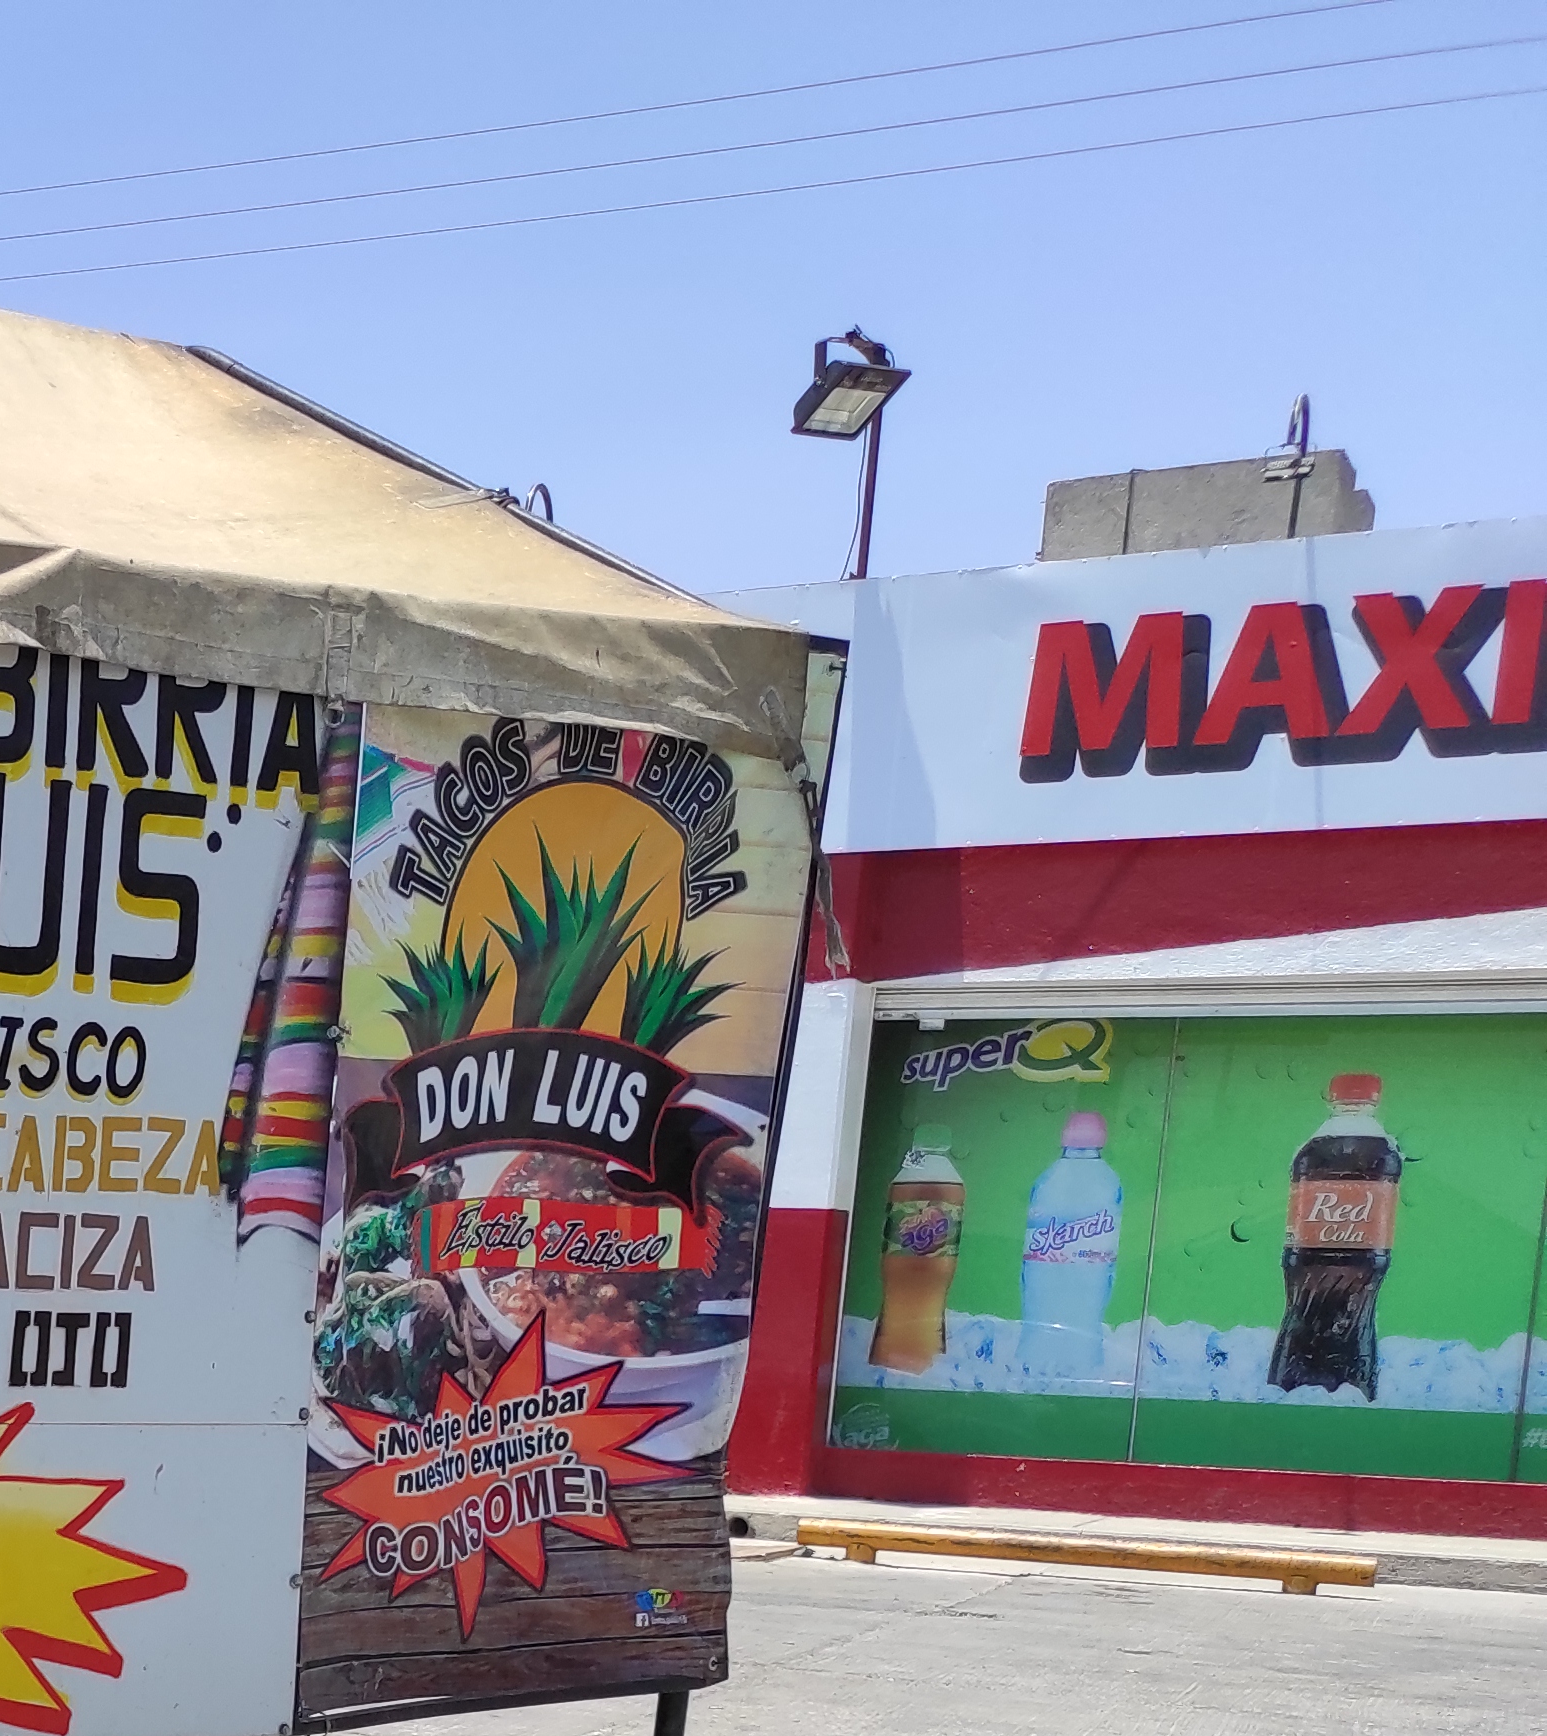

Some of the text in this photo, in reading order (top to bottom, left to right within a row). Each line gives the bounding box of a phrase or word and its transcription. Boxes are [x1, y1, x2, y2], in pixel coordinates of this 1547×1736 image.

[1019, 578, 1547, 783] MAXI
[390, 717, 532, 906] TACOS
[557, 723, 623, 775] DE
[417, 1048, 648, 1144] DON LUIS
[439, 1200, 673, 1272] Estilo Jalisco
[1304, 1190, 1374, 1223] Red
[1318, 1223, 1365, 1243] Cola
[376, 1385, 588, 1464] ¡No deje de probar
[397, 1425, 570, 1494] nuestro exquisito
[366, 1455, 607, 1575] CONSOMÉ!
